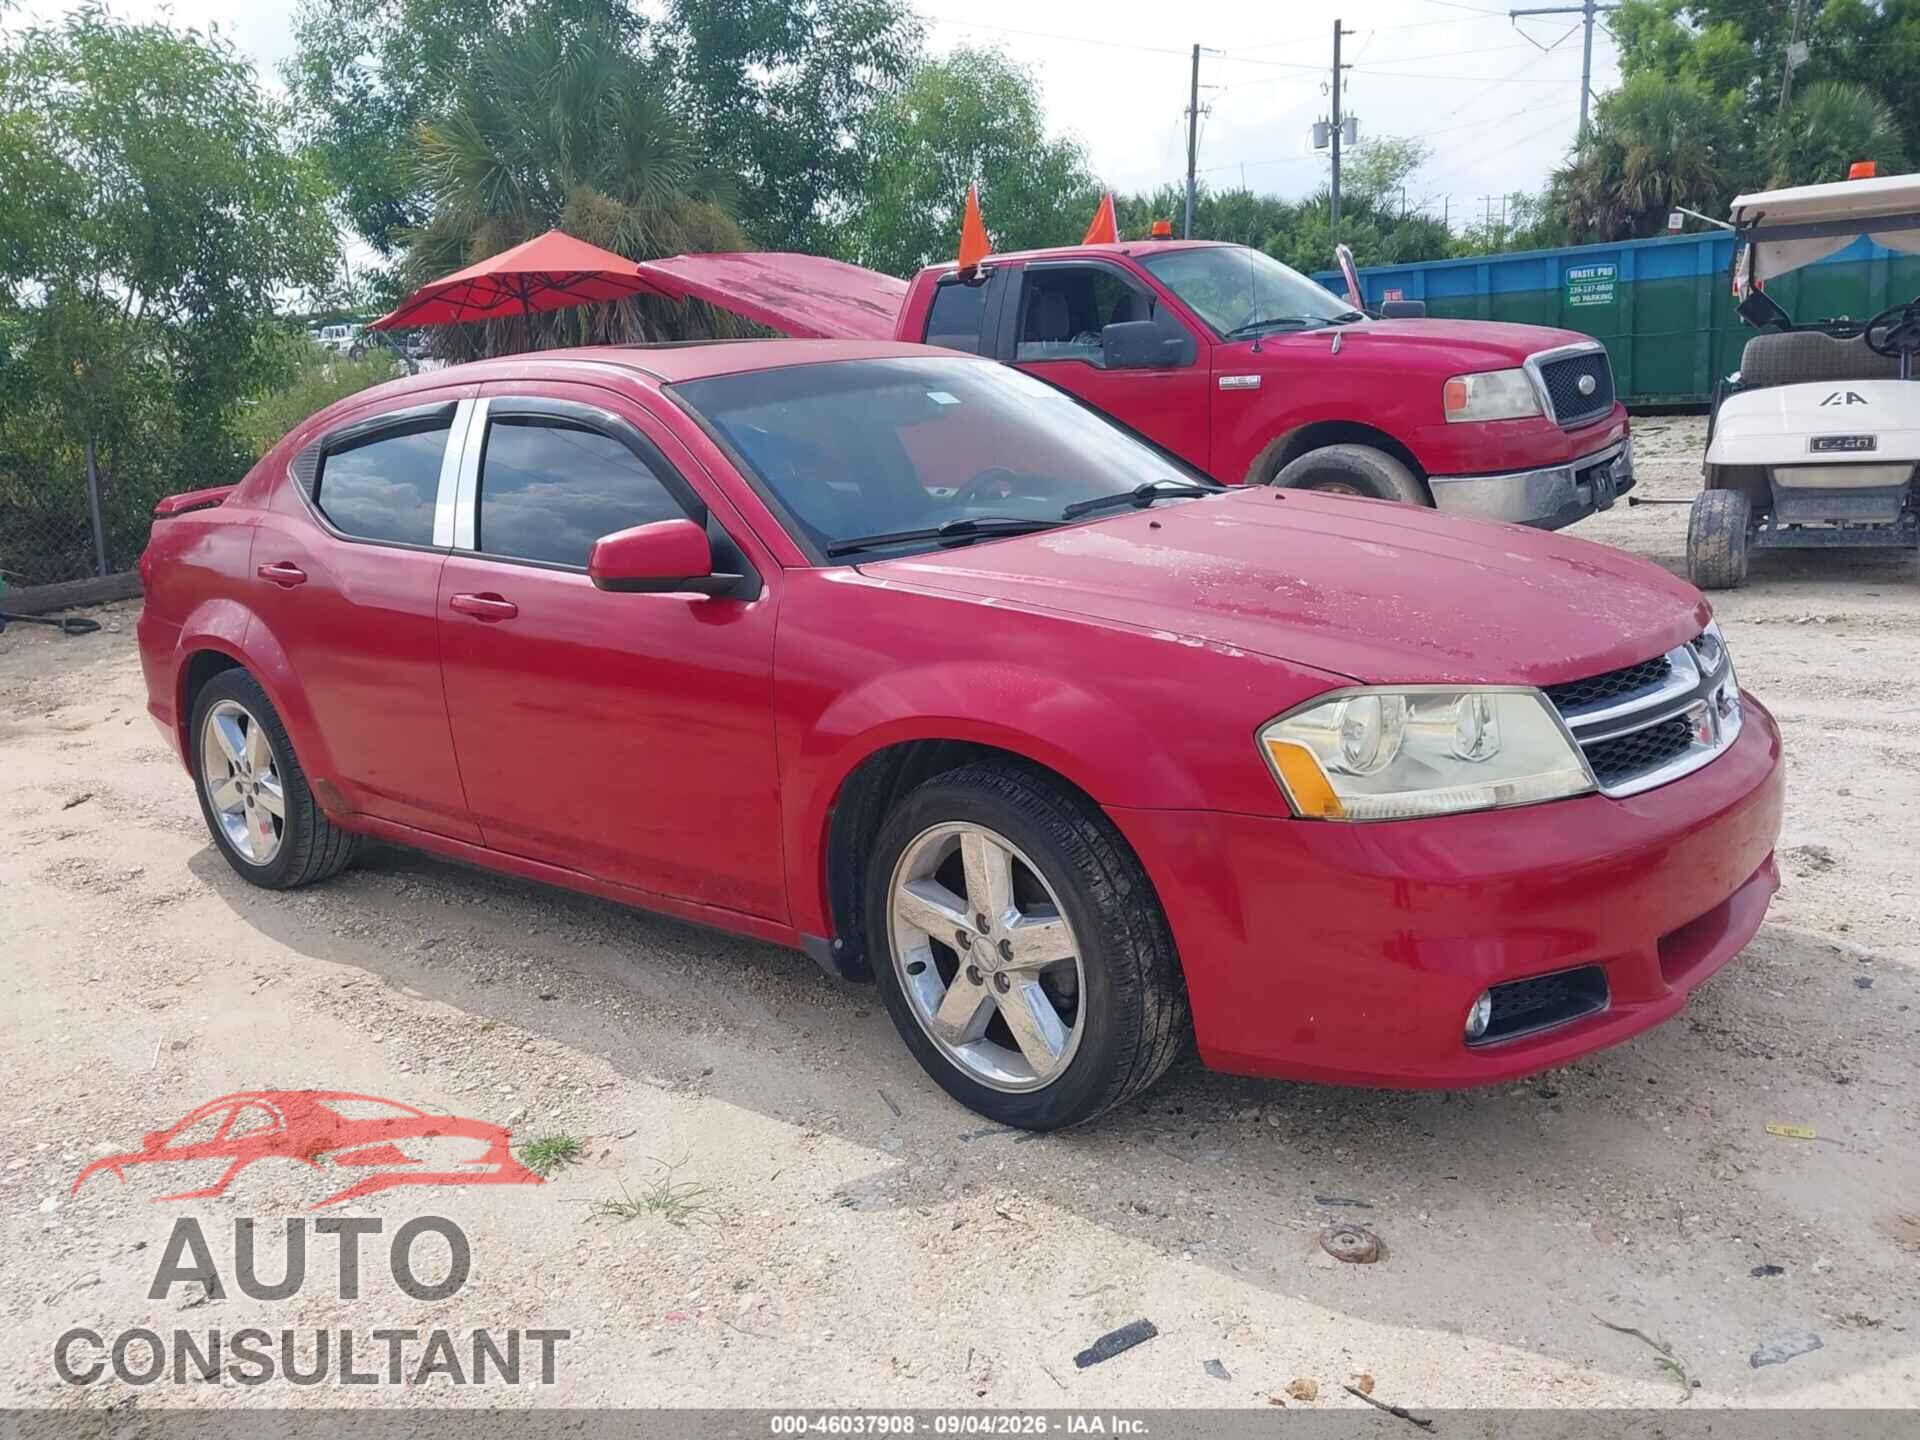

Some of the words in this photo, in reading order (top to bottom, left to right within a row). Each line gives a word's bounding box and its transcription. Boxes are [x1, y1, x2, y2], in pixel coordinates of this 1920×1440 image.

[1569, 269, 1594, 279] WASTE
[1598, 267, 1613, 276] PRO
[1569, 295, 1580, 303] NO
[1582, 293, 1613, 302] PARKING
